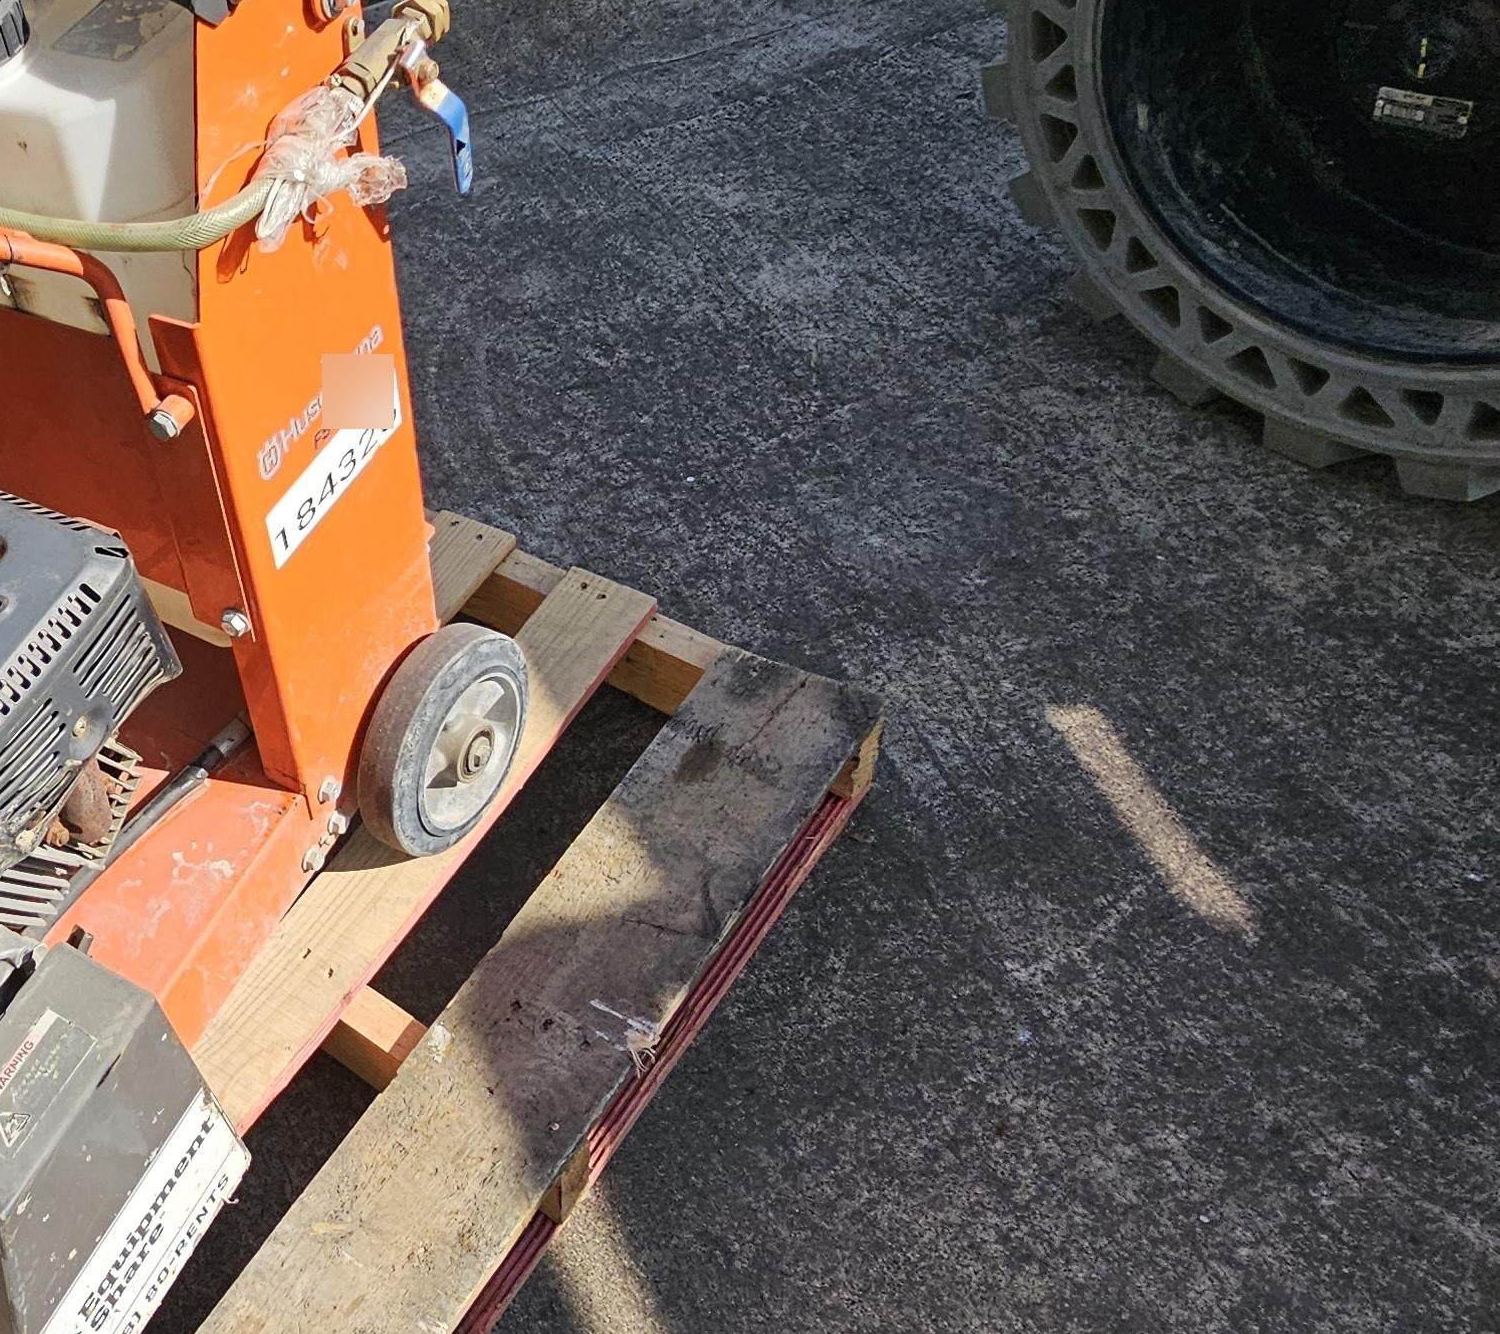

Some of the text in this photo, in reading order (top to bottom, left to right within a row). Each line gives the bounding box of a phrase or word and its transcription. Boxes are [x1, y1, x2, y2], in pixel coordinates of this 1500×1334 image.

[274, 407, 397, 552] 18432
[77, 1117, 216, 1321] Equipment
[145, 1172, 231, 1302] 80-RENTS
